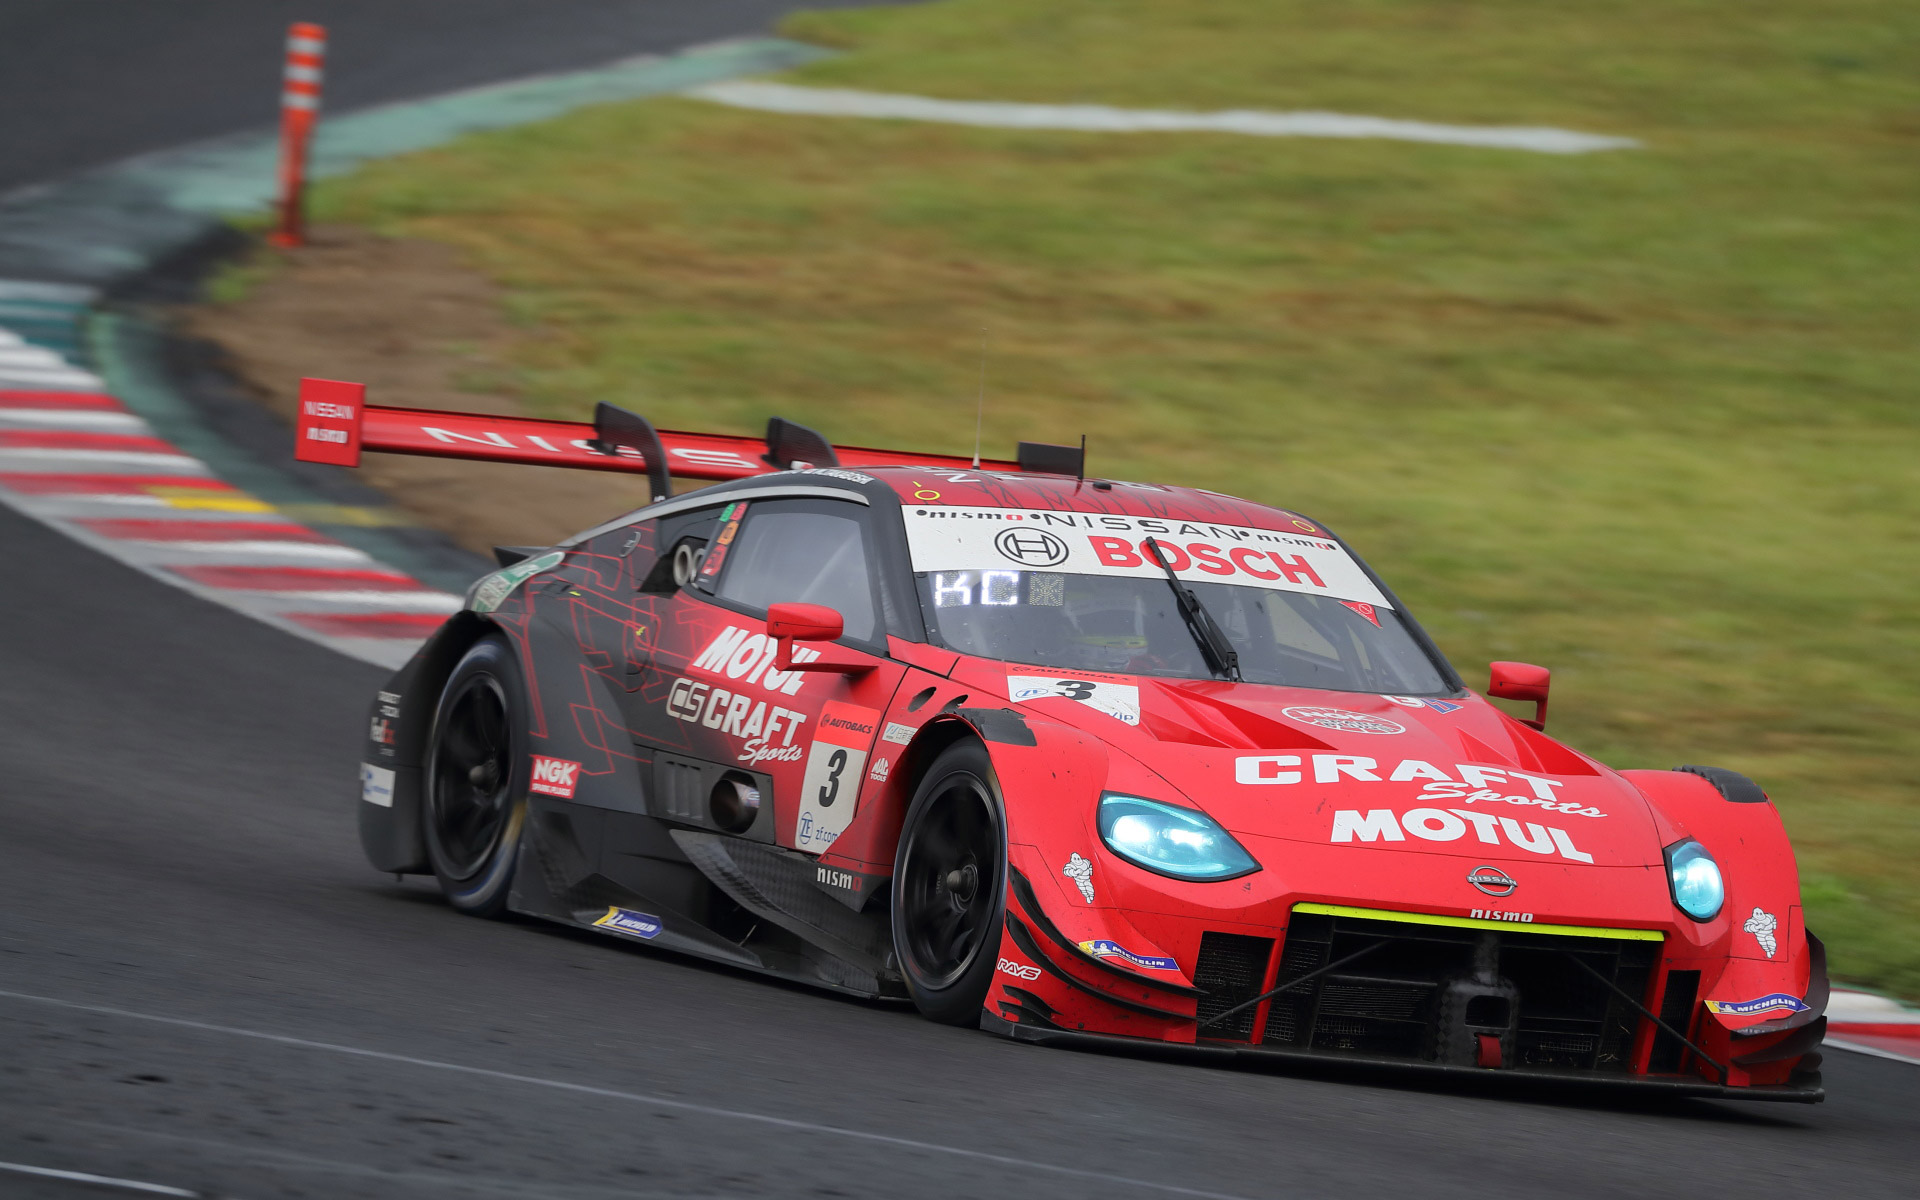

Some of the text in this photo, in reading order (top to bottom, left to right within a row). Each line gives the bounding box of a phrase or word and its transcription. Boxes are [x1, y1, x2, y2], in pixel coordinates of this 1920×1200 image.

[303, 400, 355, 420] NISSAN
[929, 511, 1330, 551] nismo NISSAN nismo
[1087, 535, 1328, 588] BOSCH
[692, 625, 822, 696] MOTUL
[1055, 680, 1097, 701] 3
[702, 688, 807, 747] CRAFT
[829, 718, 873, 734] AUTOBACS
[738, 738, 803, 767] Sports
[533, 758, 577, 786] NGK
[818, 749, 848, 808] 3
[870, 773, 888, 783] TOOLS
[1235, 754, 1563, 802] CRAFT
[1416, 781, 1608, 818] Sports
[815, 827, 842, 844] zf.com
[1330, 807, 1595, 864] MOTUL
[816, 867, 863, 892] nismo
[1468, 875, 1517, 886] NISSAN
[1470, 908, 1534, 923] nismo
[1112, 945, 1165, 967] MICHELIN
[997, 957, 1042, 981] RAYS
[1737, 998, 1796, 1013] MICHELIN
